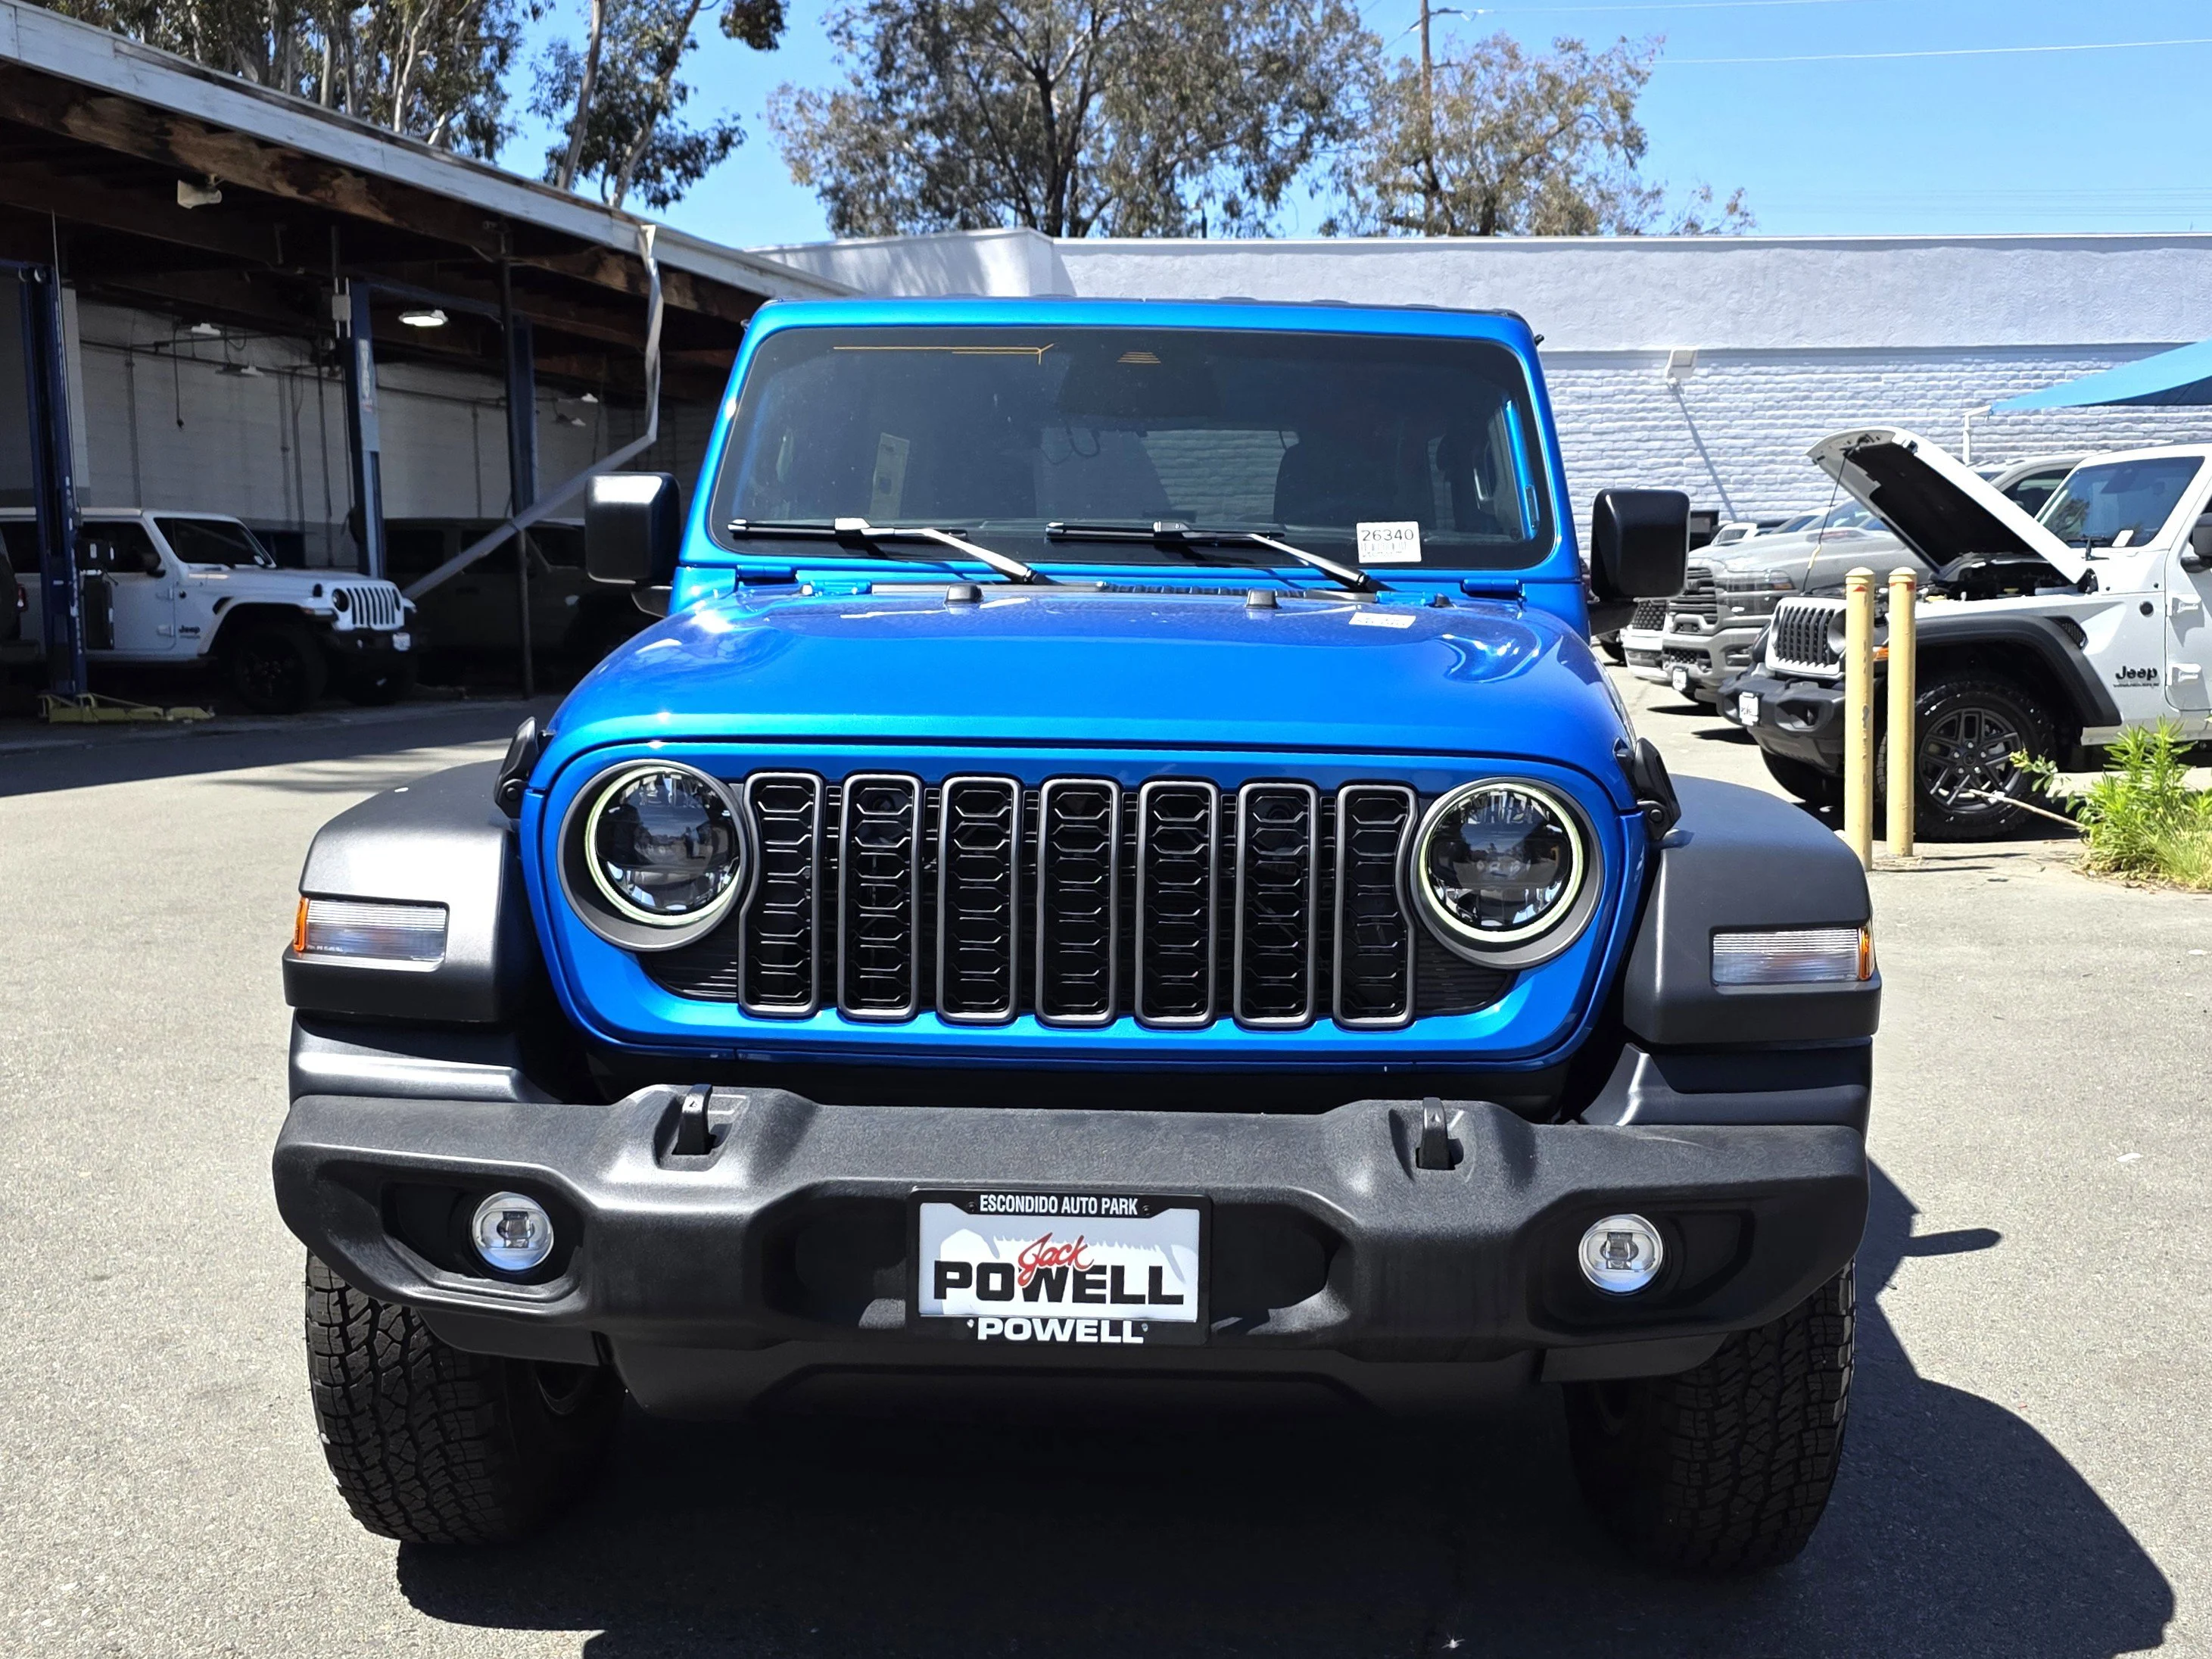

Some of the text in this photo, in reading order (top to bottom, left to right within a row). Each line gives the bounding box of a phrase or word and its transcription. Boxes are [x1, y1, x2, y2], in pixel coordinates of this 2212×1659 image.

[1361, 529, 1414, 541] 26340
[2115, 666, 2157, 681] Jeep
[980, 1194, 1138, 1215] ESCONDIDO AUTO PARK
[1017, 1232, 1094, 1286] Jack
[933, 1260, 1184, 1305] POWELL
[977, 1318, 1144, 1344] POWELL
